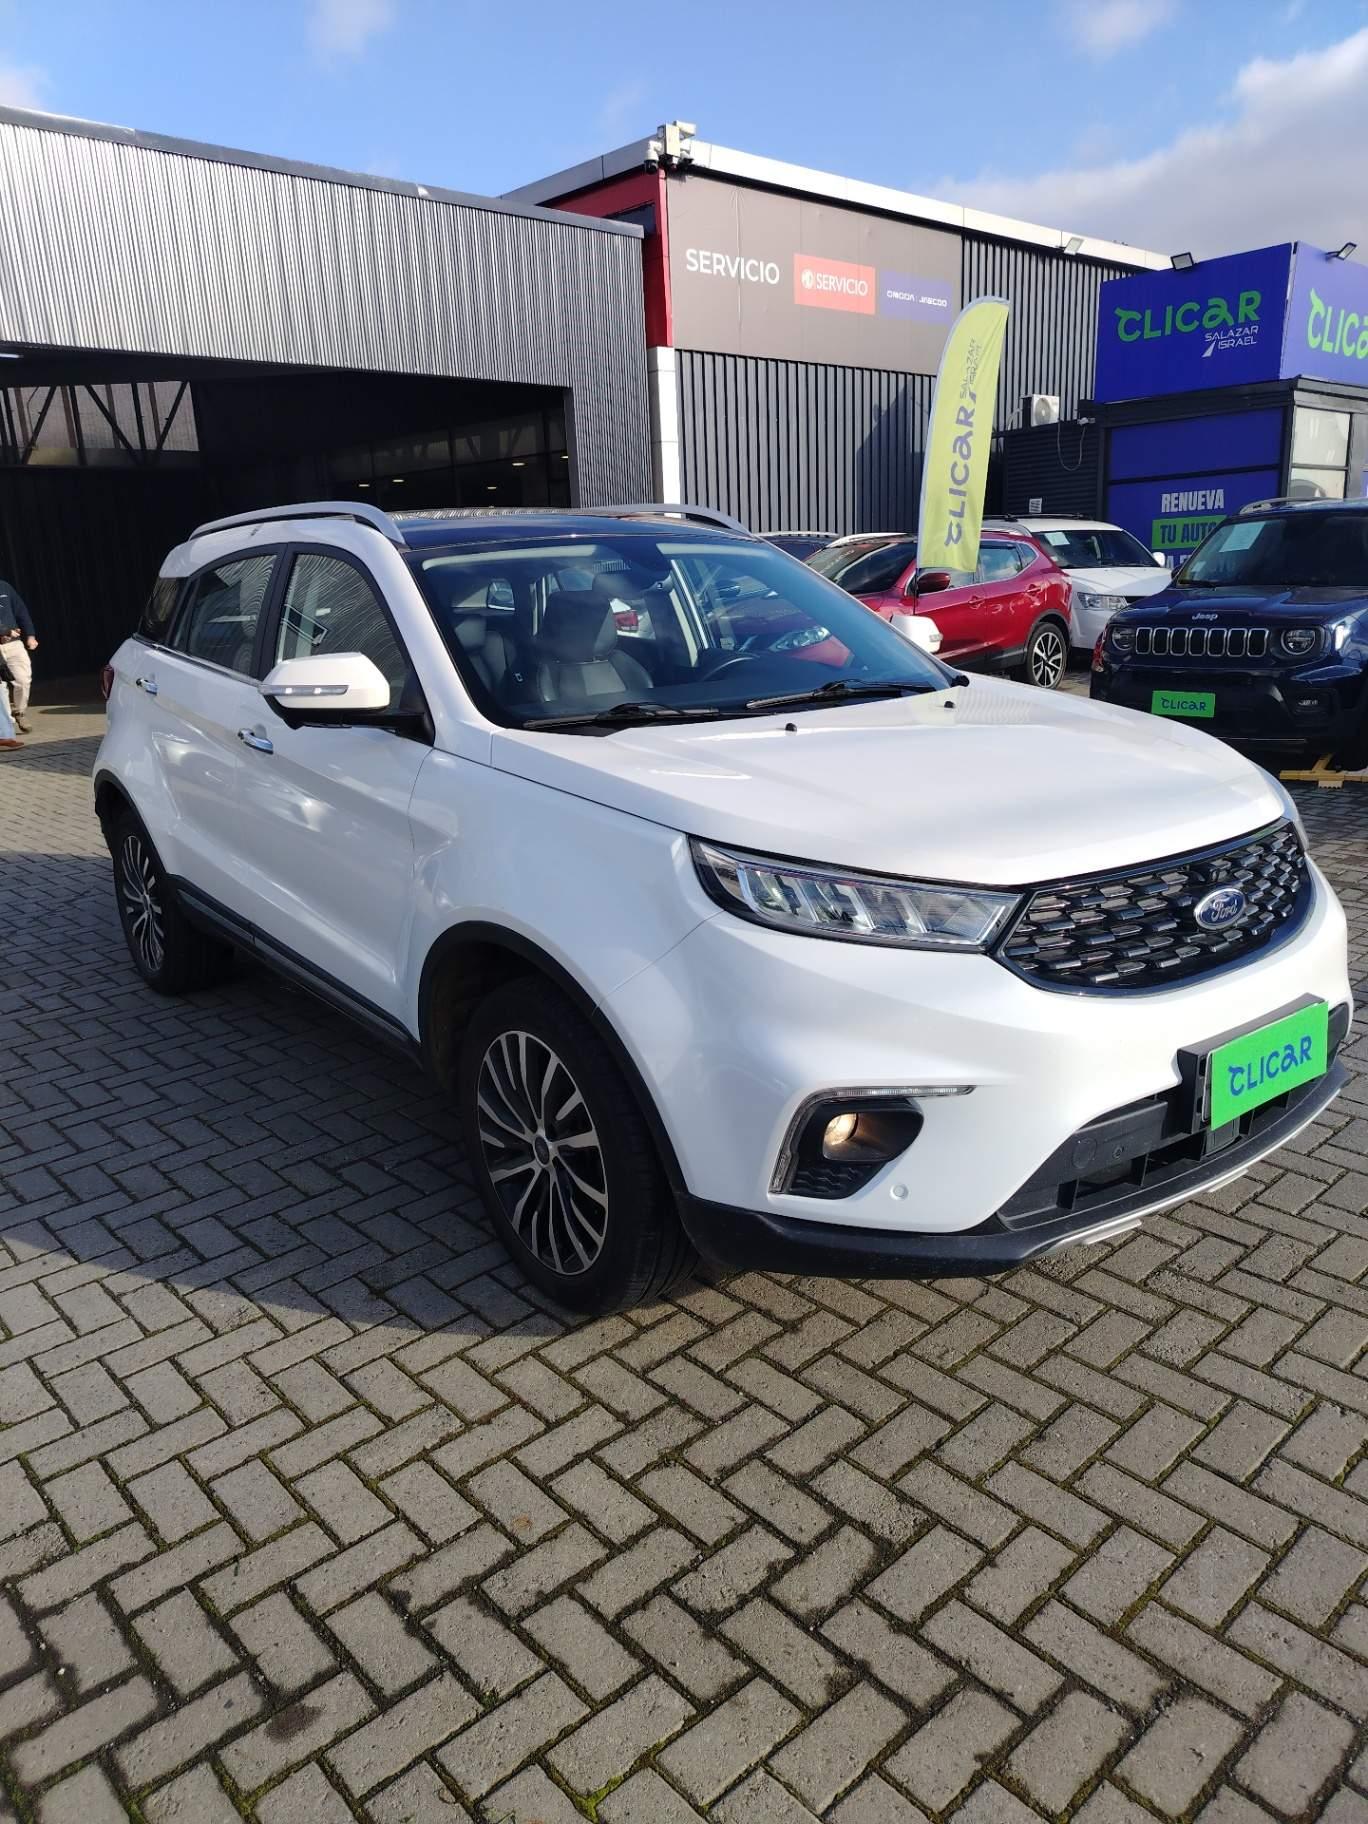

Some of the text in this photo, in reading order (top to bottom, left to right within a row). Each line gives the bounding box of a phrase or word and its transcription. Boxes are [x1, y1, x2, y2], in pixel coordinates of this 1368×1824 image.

[685, 248, 780, 285] SERVICIO
[816, 272, 868, 297] SERVICIO
[1205, 325, 1259, 342] SALAZAR
[1218, 336, 1257, 350] ISRAEL
[1161, 489, 1224, 513] RENUEVA
[1160, 524, 1176, 544] TU
[1192, 613, 1219, 621] Jeep
[1210, 893, 1238, 922] Ford
